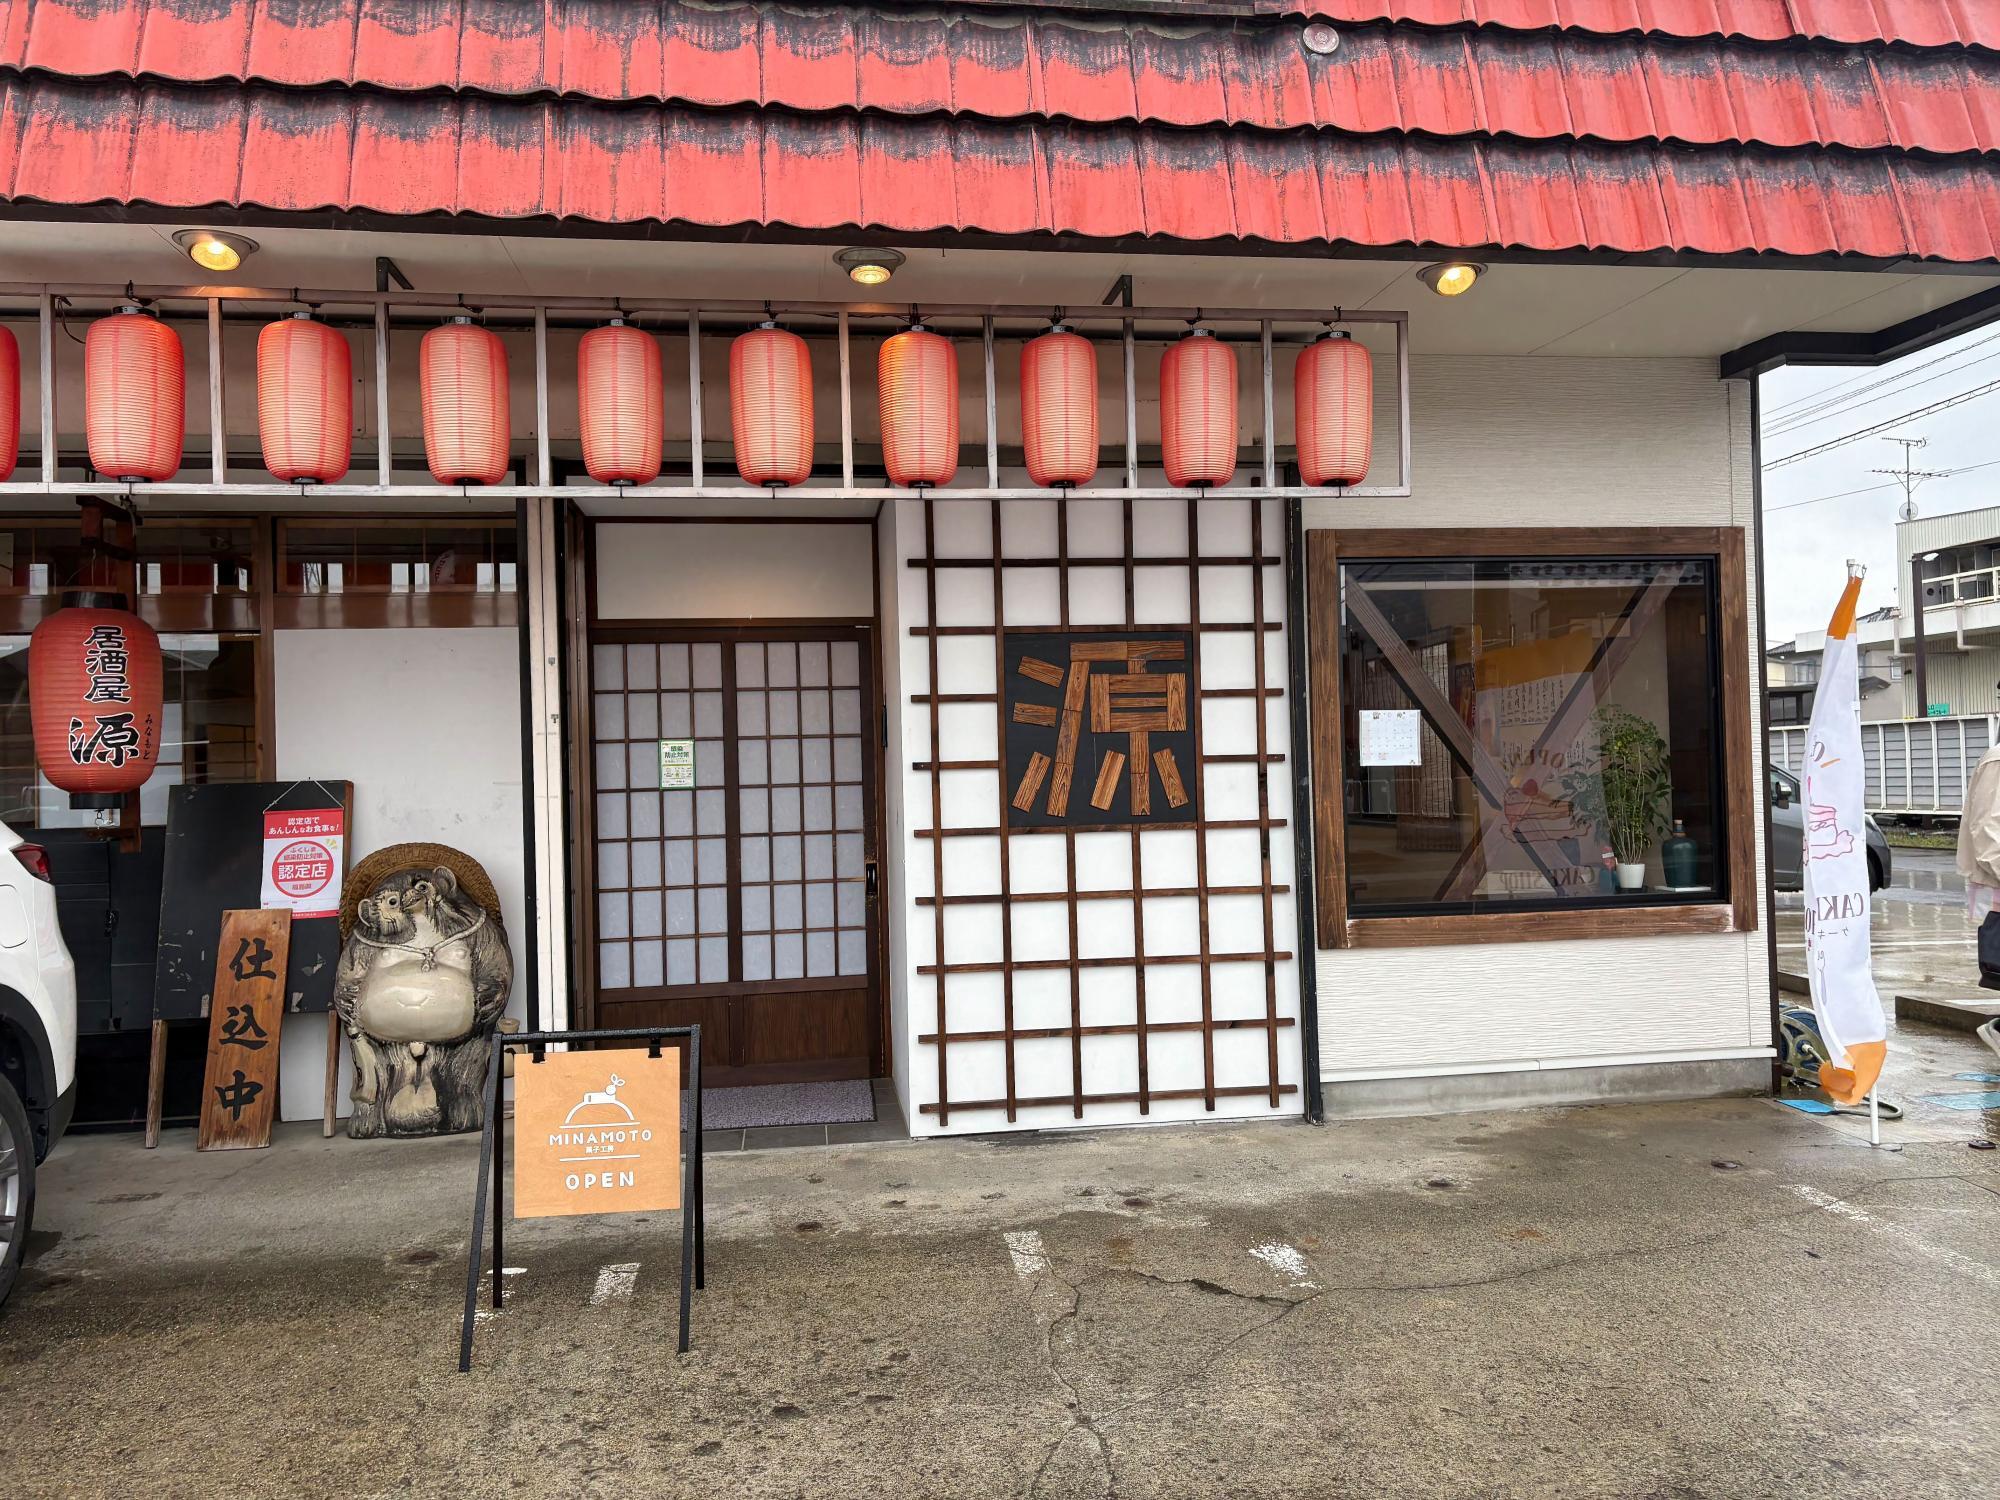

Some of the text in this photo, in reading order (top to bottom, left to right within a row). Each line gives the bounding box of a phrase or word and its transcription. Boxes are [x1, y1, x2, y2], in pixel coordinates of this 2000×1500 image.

[83, 625, 132, 704] 居酒屋
[68, 712, 140, 768] 源
[142, 713, 154, 760] みなもと
[1012, 640, 1190, 817] 源
[287, 816, 320, 826] 認定店で
[278, 863, 328, 880] 認定店
[215, 937, 277, 1122] 仕込中
[549, 1129, 652, 1146] MINAMOTO
[565, 1171, 635, 1190] OPEN
